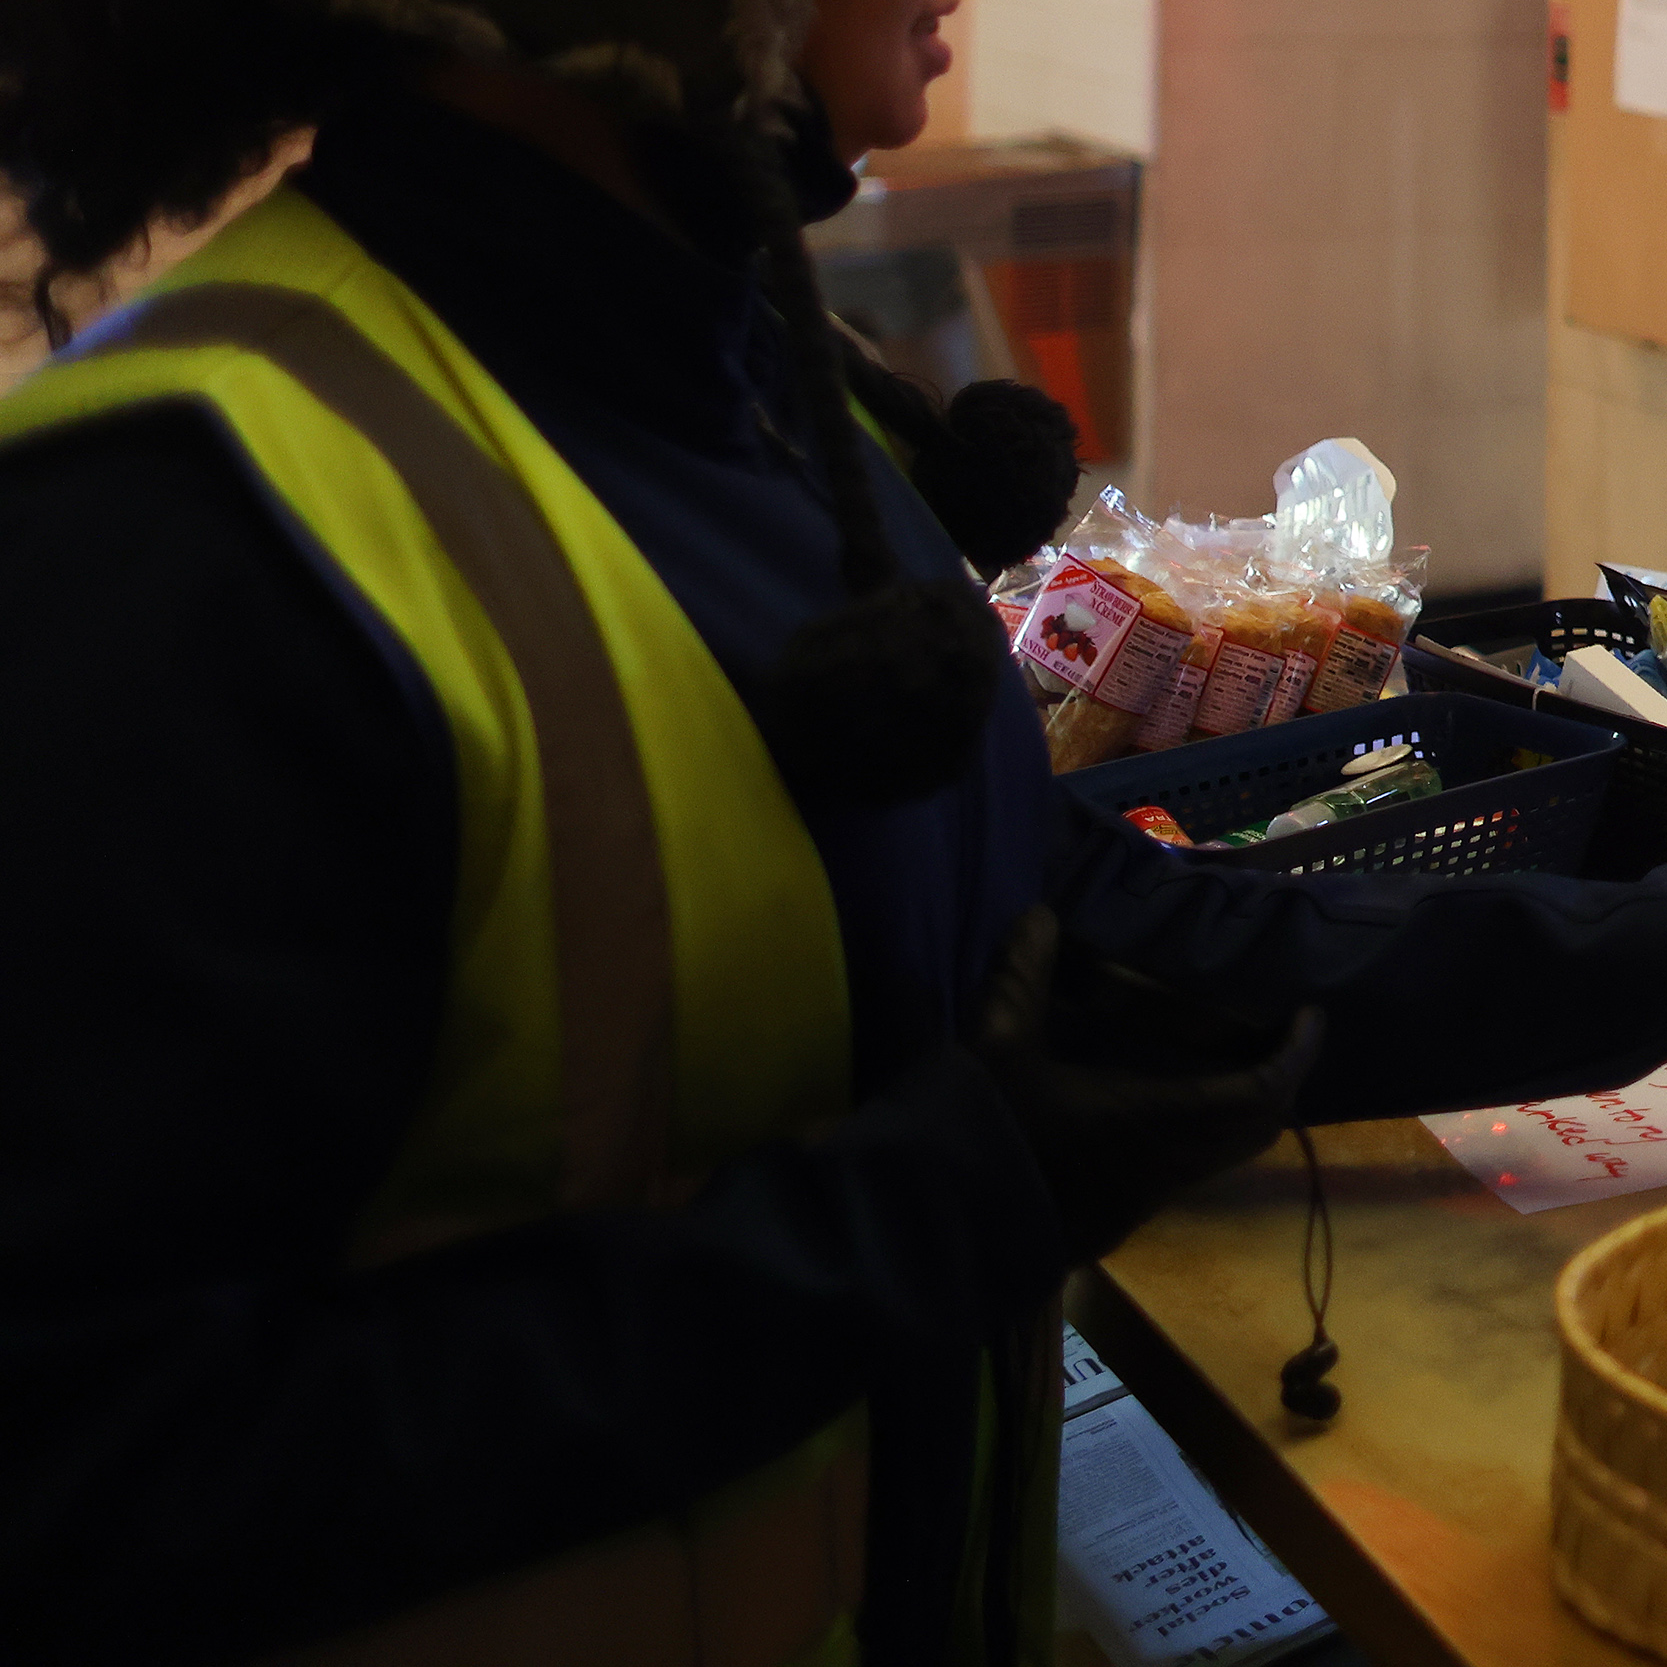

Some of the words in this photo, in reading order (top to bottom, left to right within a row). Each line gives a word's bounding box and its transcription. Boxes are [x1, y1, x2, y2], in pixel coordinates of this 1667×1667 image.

[1110, 1533, 1207, 1587] attack
[1143, 1547, 1218, 1590] after
[1163, 1559, 1229, 1597] dies
[1128, 1572, 1240, 1634] worker
[1155, 1584, 1251, 1639] Social
